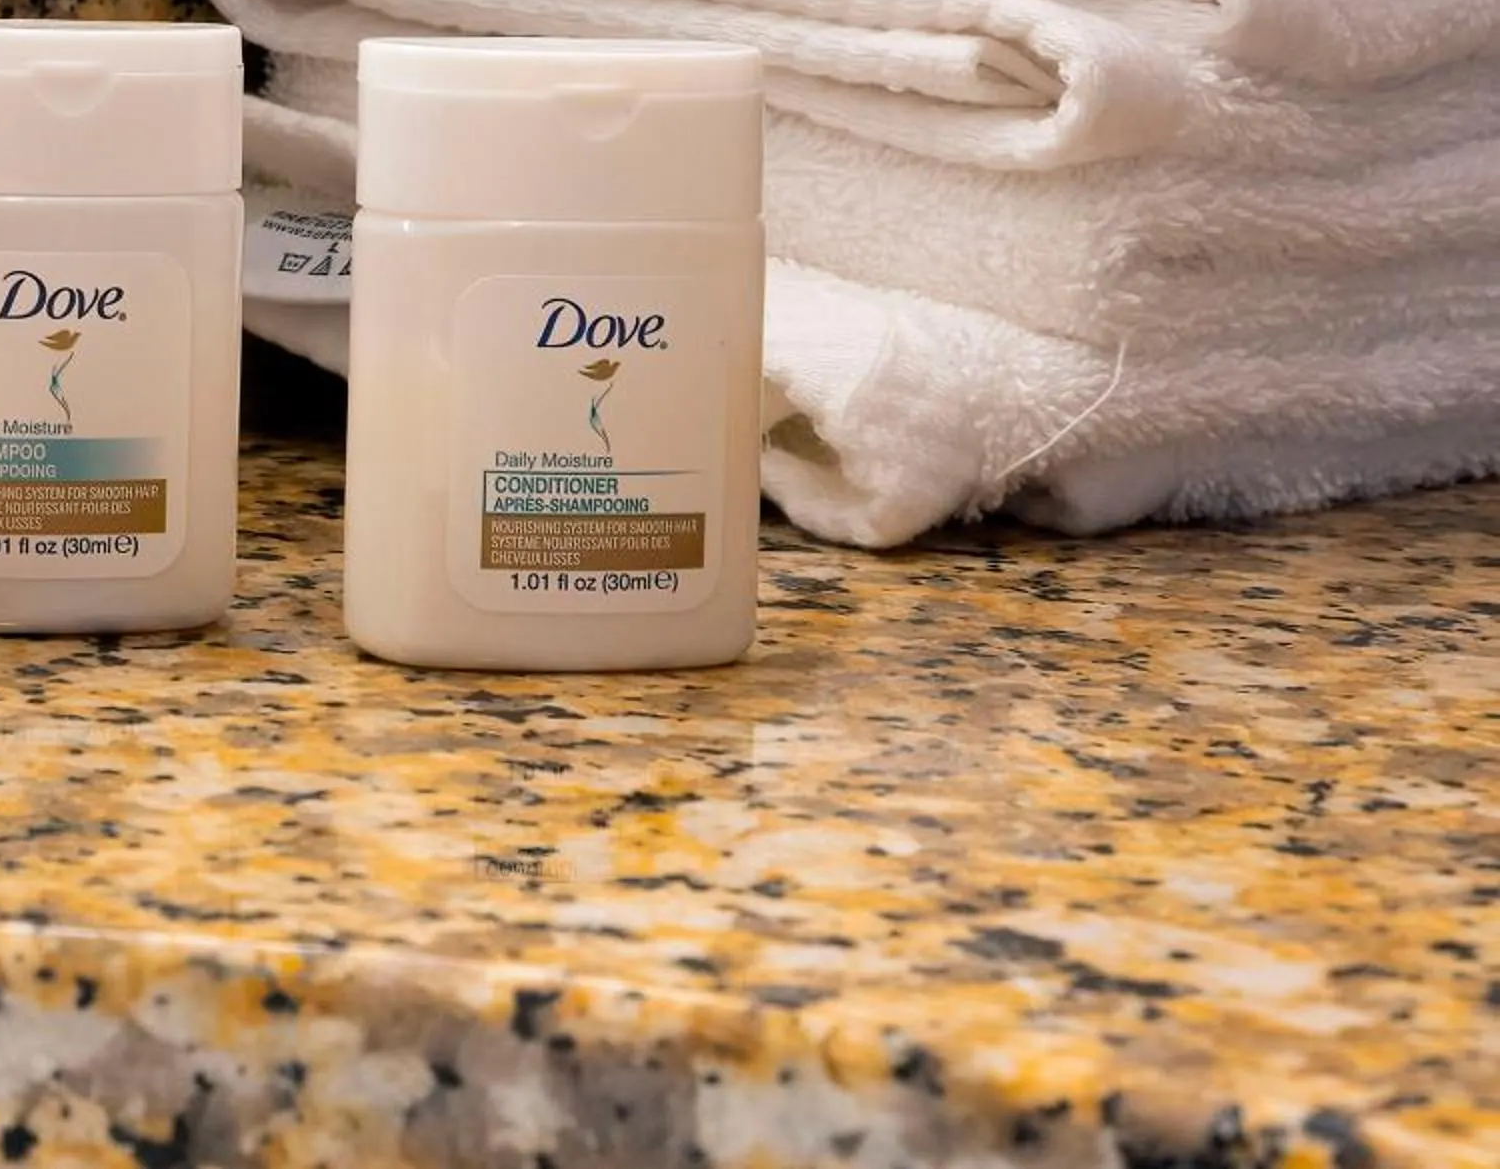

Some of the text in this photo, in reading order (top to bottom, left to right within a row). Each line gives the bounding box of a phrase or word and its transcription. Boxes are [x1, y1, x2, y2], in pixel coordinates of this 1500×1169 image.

[537, 298, 665, 348] Dove
[3, 419, 73, 435] Moisture
[495, 451, 613, 470] Daily Moisture
[495, 476, 619, 494] CONDITIONER
[18, 537, 29, 554] fl
[35, 541, 58, 555] oz
[511, 573, 548, 590] 1.01
[557, 573, 569, 591] fl
[574, 577, 597, 591] oz
